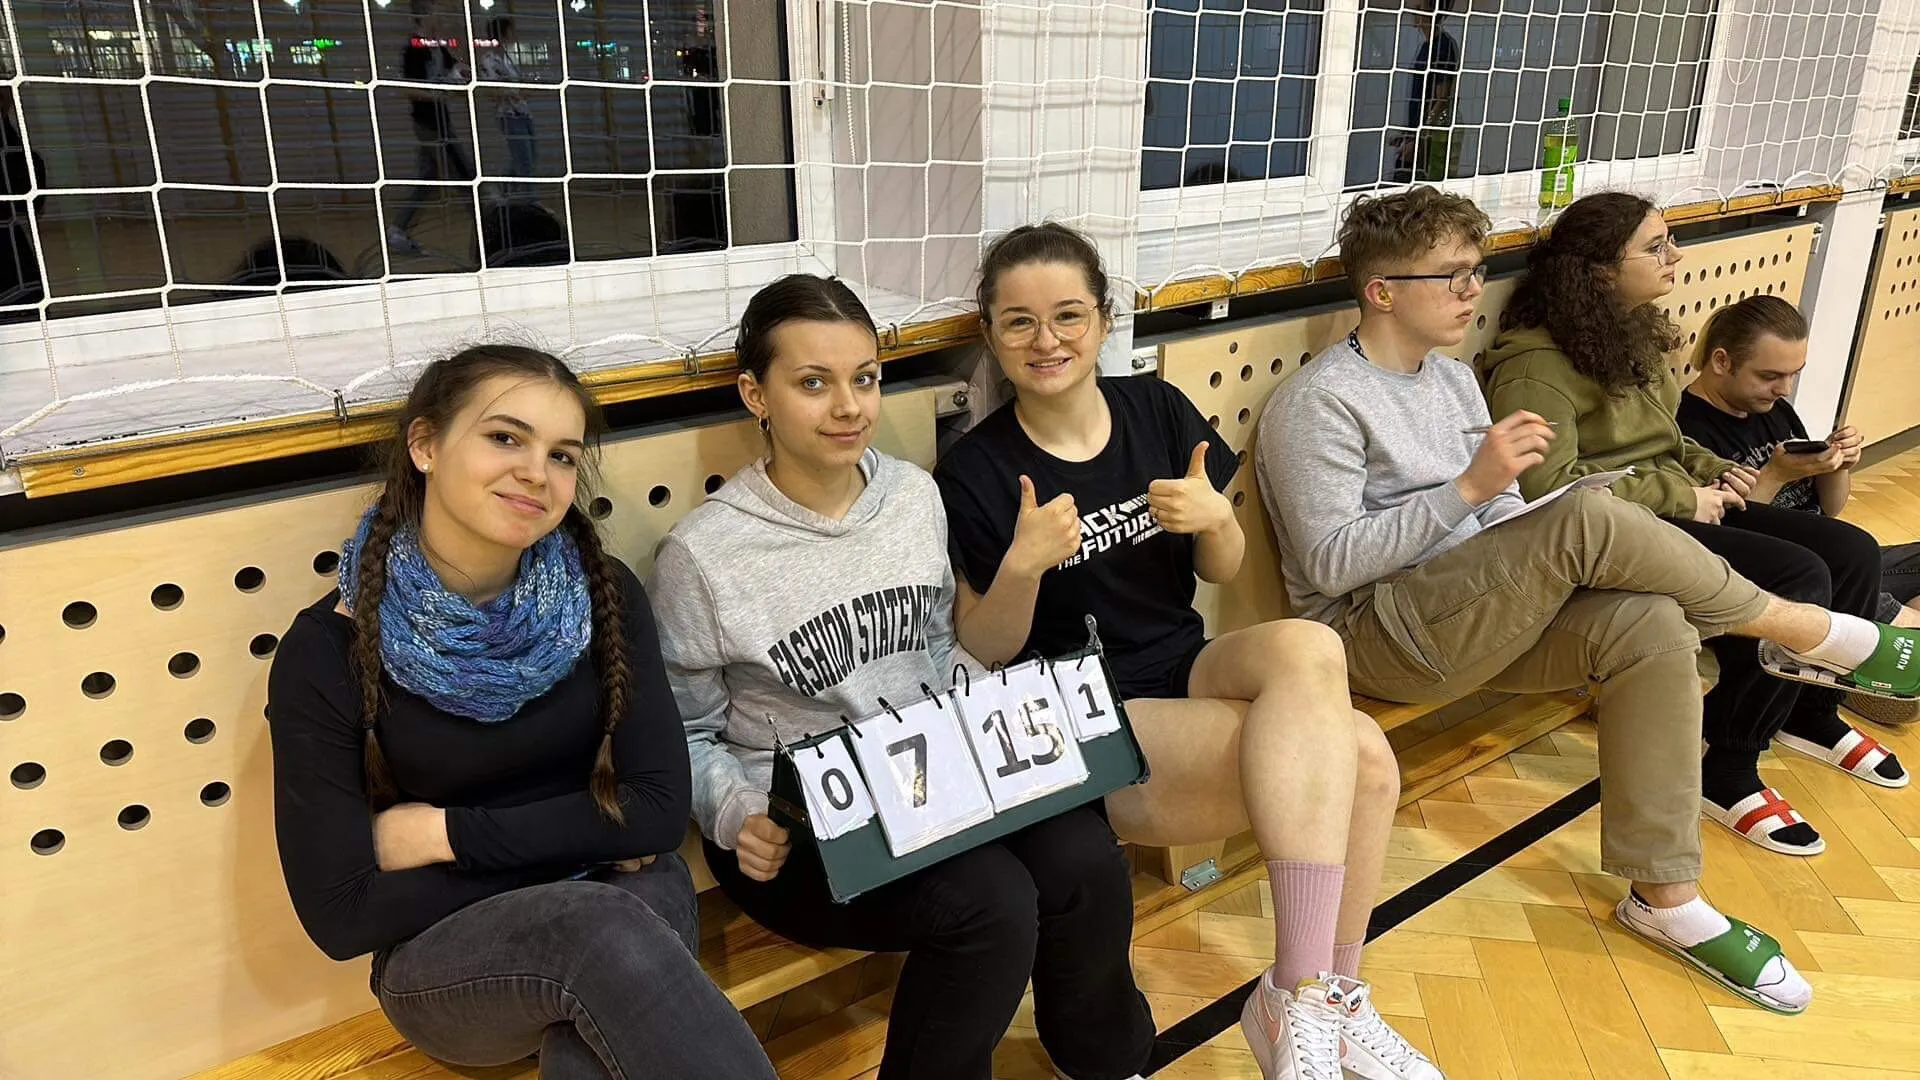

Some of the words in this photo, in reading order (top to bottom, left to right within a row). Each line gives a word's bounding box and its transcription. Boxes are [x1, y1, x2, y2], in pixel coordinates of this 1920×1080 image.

[1080, 503, 1128, 540] ACK
[1082, 512, 1158, 561] FUTUR
[768, 603, 856, 697] FASHION
[1896, 640, 1914, 670] KUBOTA
[820, 767, 855, 811] 0
[886, 732, 928, 808] 7
[982, 697, 1065, 778] 15
[1077, 682, 1106, 720] 1
